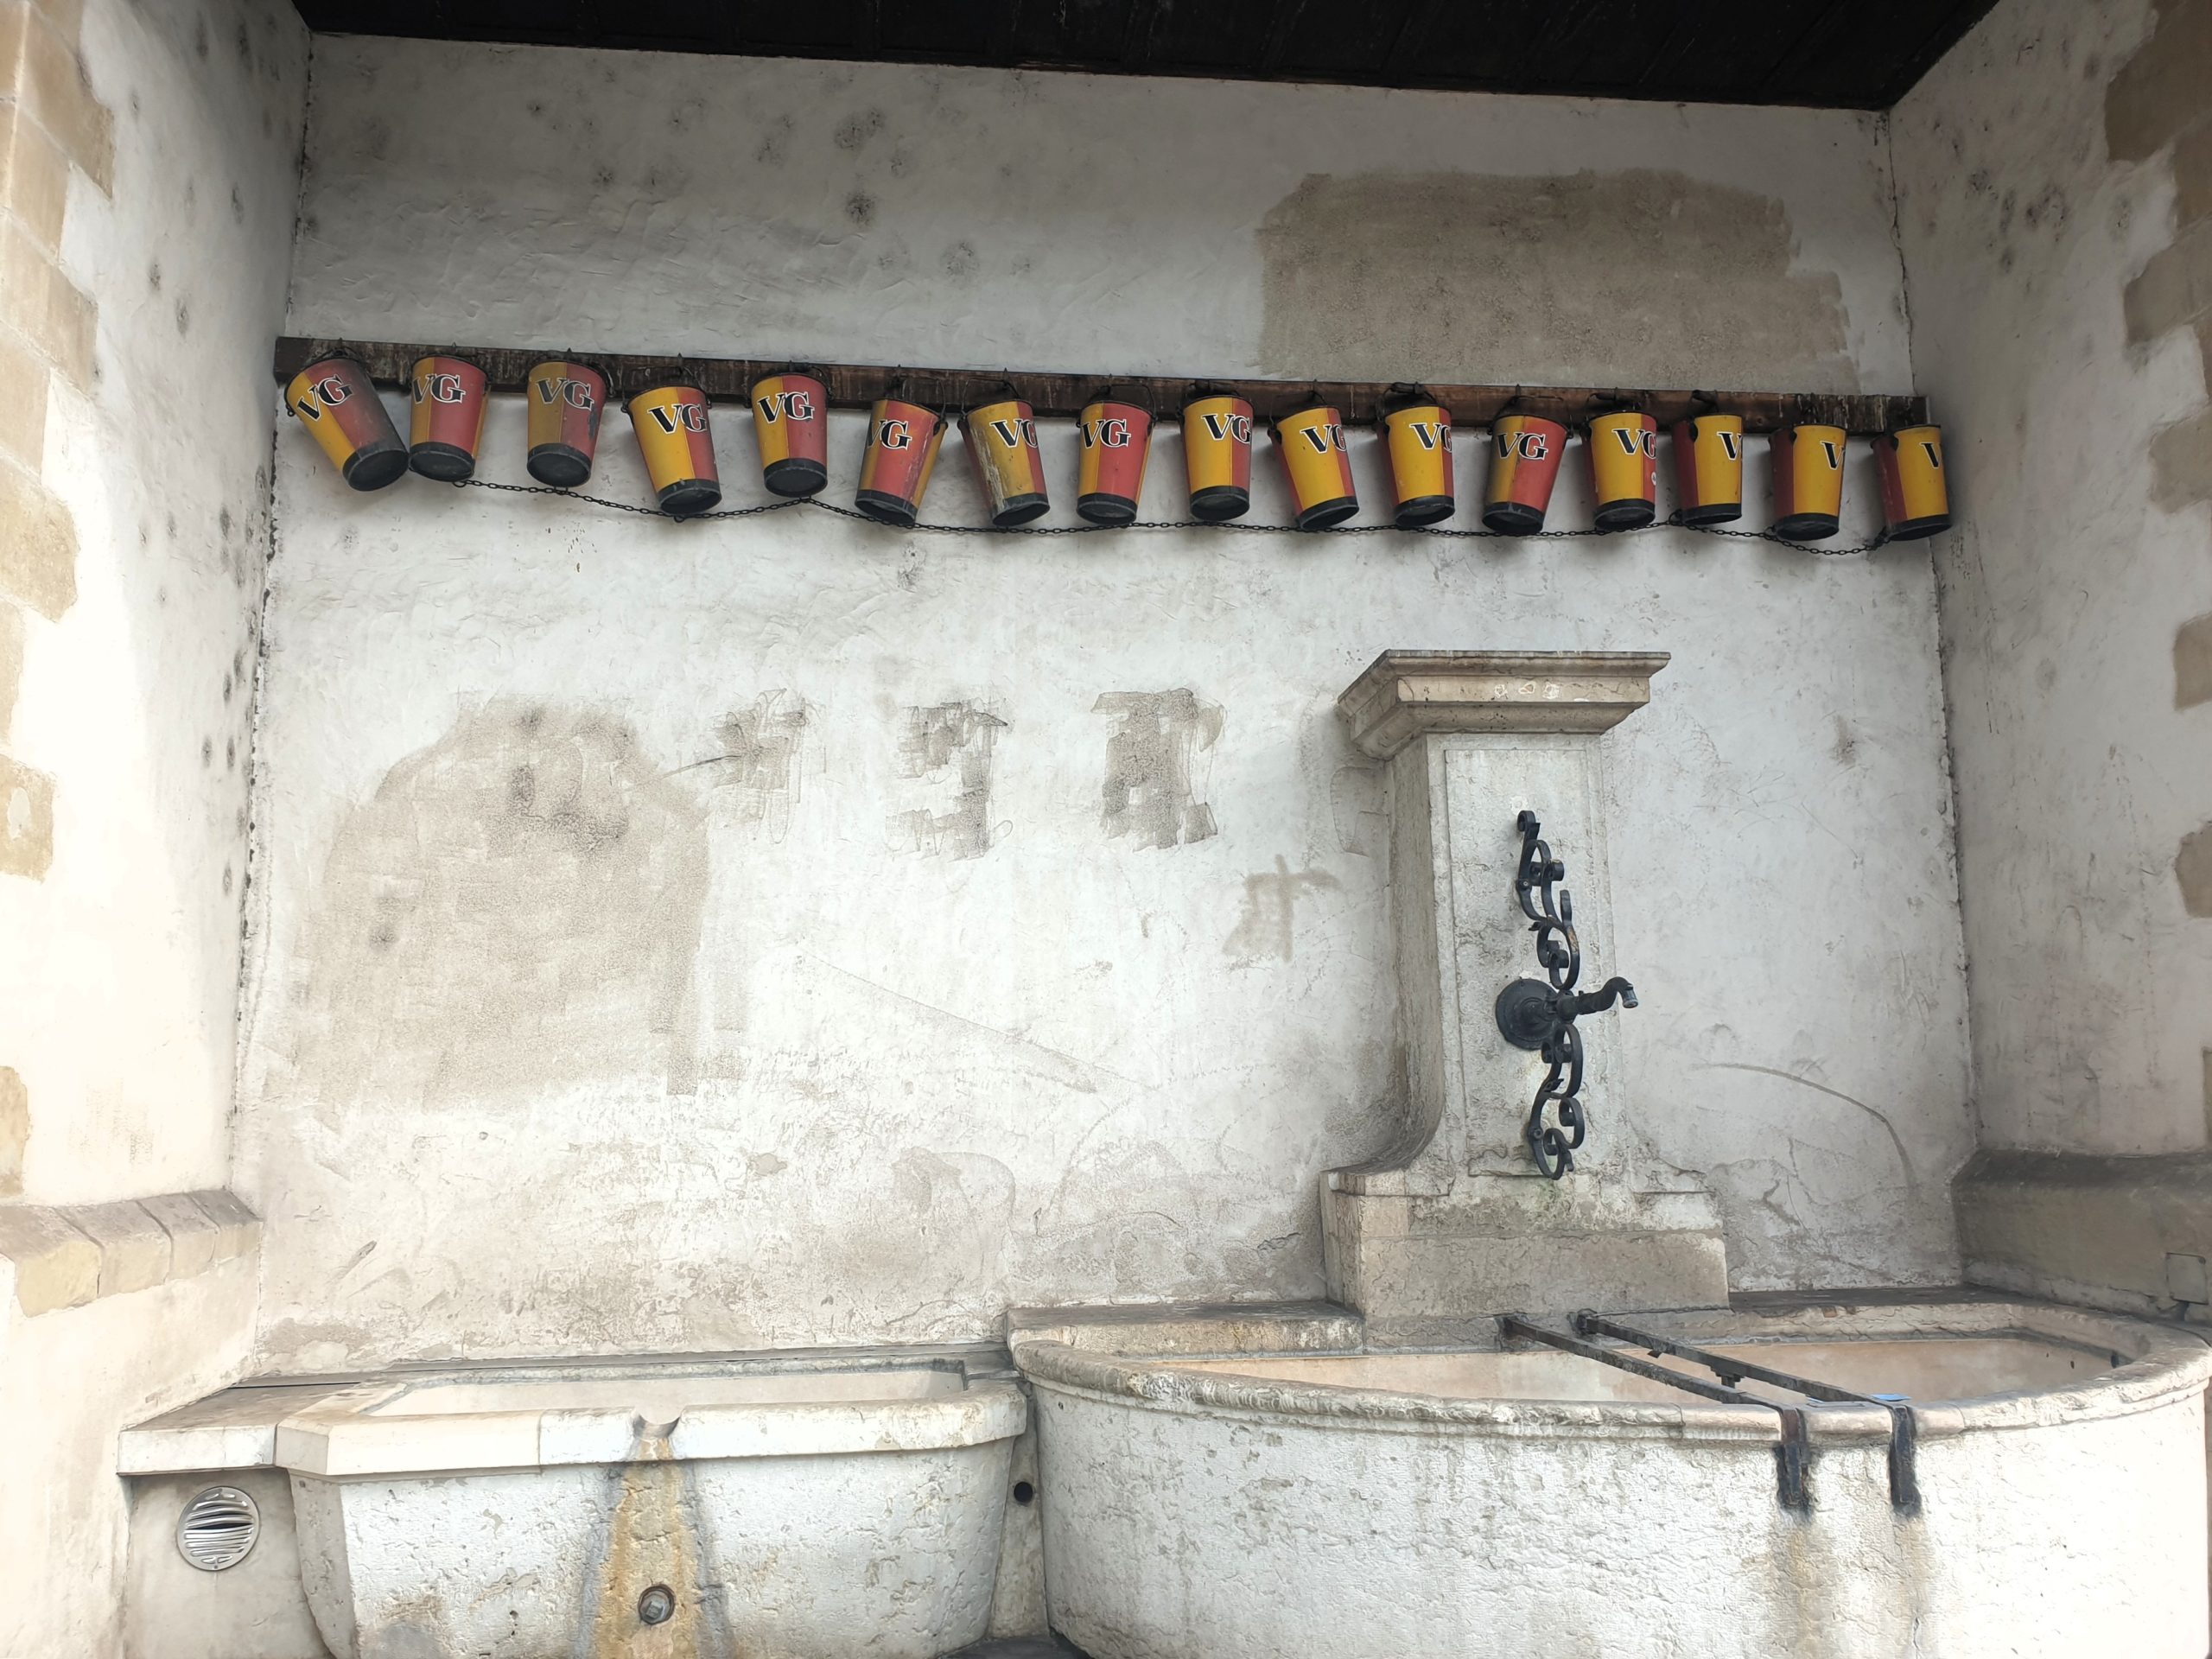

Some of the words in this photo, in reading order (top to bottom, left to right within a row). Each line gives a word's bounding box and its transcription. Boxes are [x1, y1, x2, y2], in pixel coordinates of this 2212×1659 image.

[296, 374, 353, 422] VG
[412, 373, 467, 404] VG
[536, 378, 595, 411] VG
[647, 403, 707, 434] VG
[757, 391, 815, 423] VG
[867, 419, 912, 450] VG
[1081, 419, 1131, 448] VG
[1201, 414, 1251, 444] VG
[1497, 433, 1548, 461] VG
[1821, 442, 1846, 470] V
[1919, 442, 1942, 469] V
